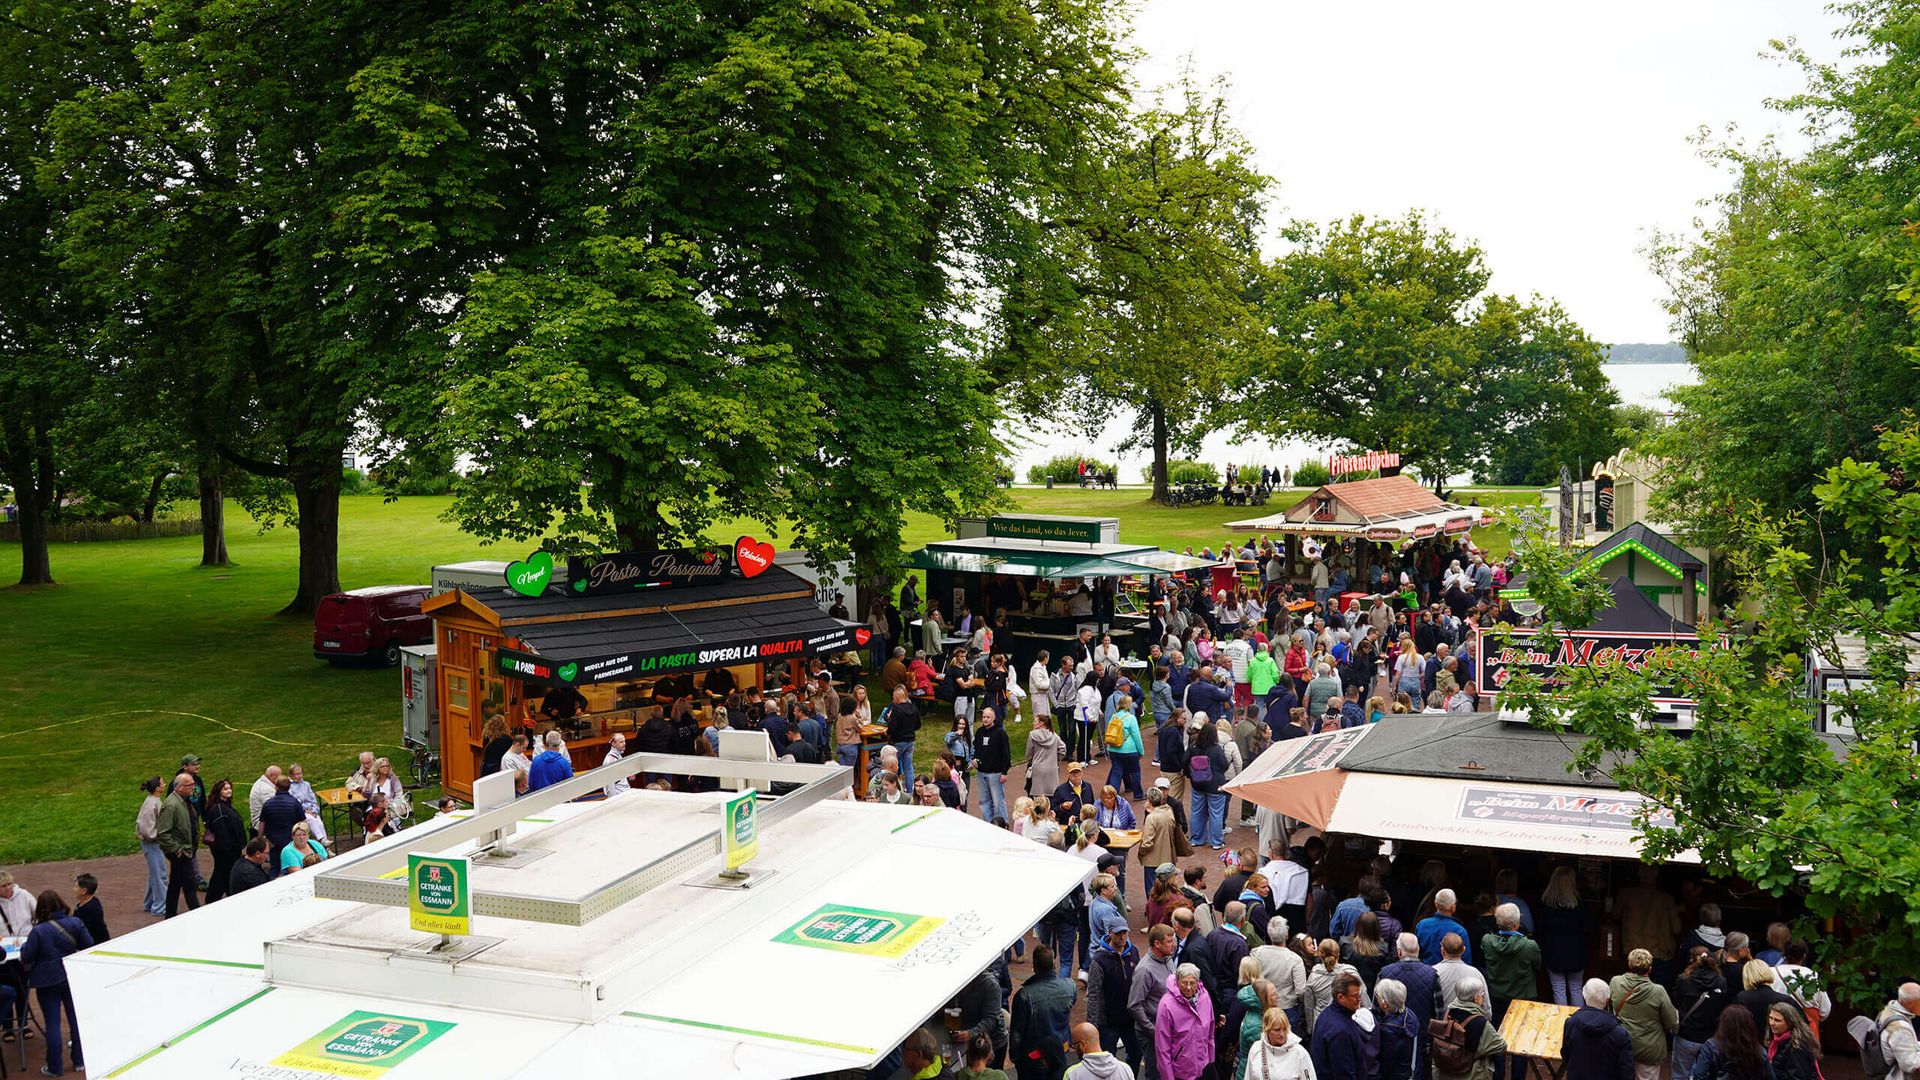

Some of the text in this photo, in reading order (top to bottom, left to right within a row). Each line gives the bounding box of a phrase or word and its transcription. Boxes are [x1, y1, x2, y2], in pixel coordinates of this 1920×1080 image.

[993, 523, 1008, 532] Wie
[1009, 524, 1021, 533] das
[1022, 525, 1043, 535] Land,
[1054, 527, 1066, 536] das
[589, 553, 722, 588] Pasta Passquali
[641, 639, 803, 671] LA PASTA SUPERA LA QUALITA
[421, 896, 453, 906] ESSMANN
[326, 1042, 387, 1057] ESSMANN
[356, 1041, 375, 1049] VON
